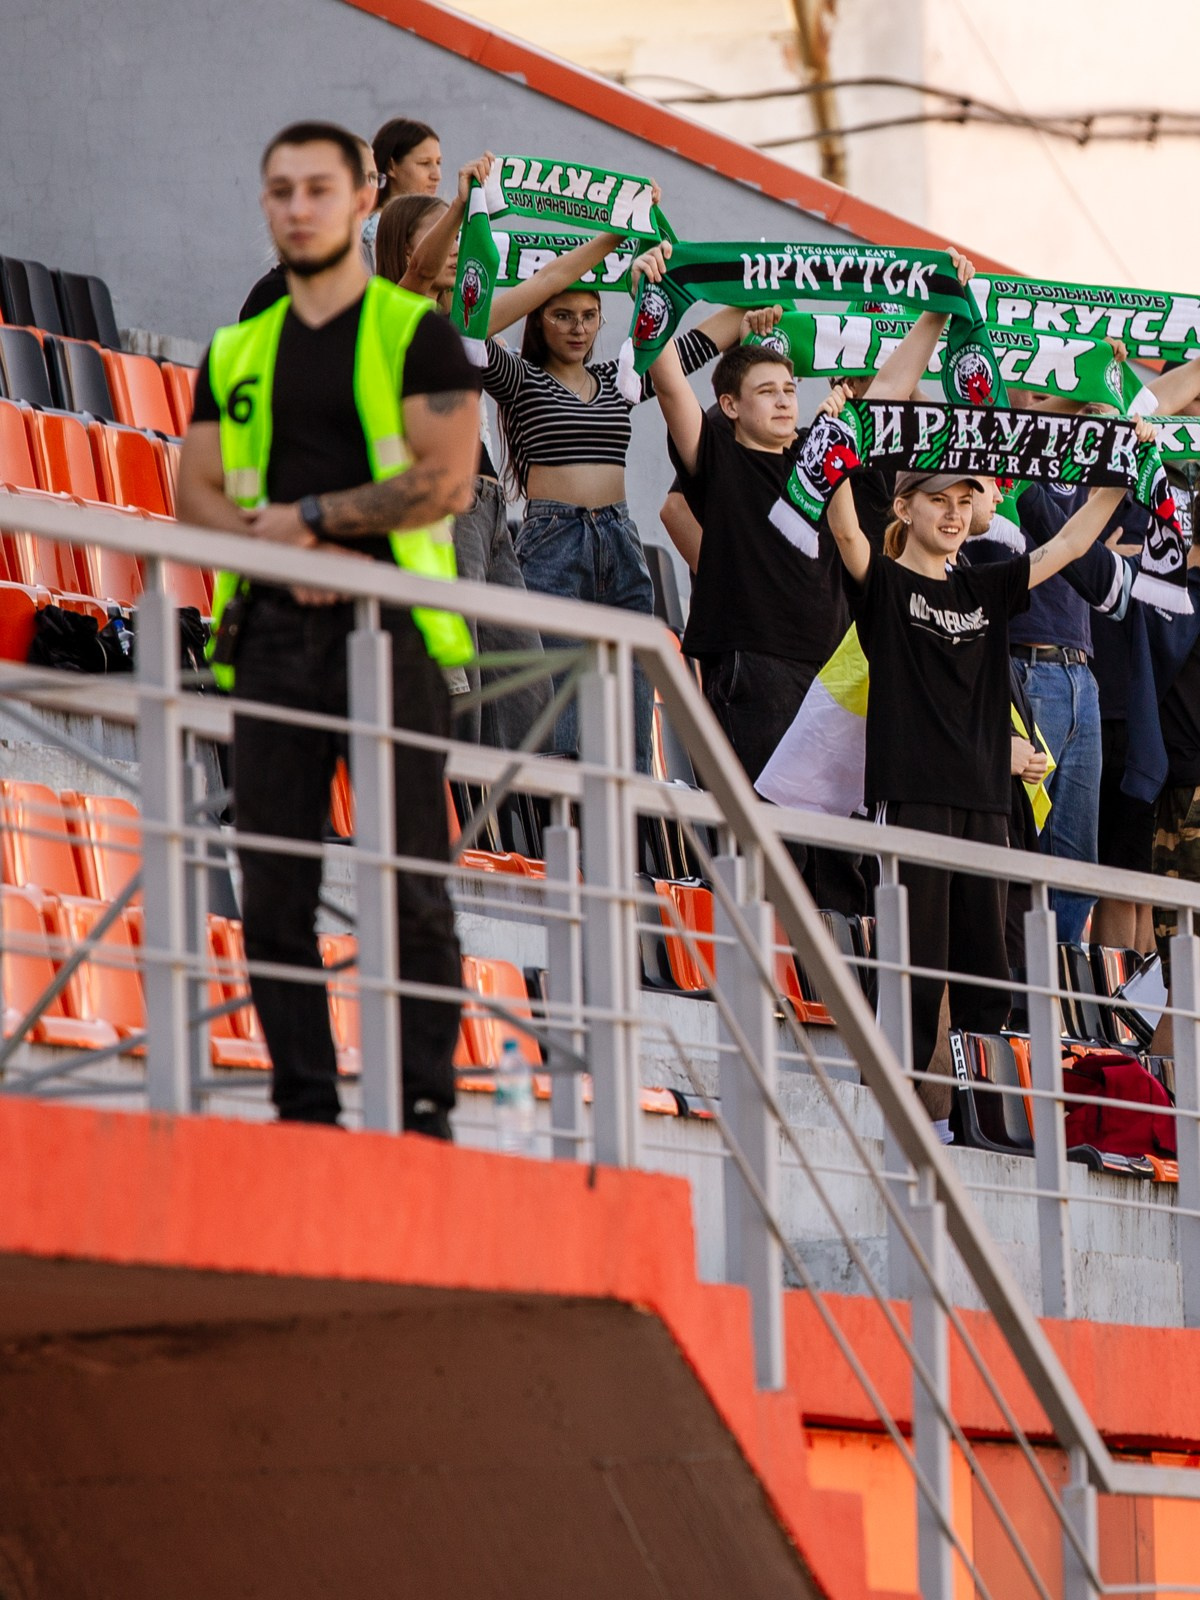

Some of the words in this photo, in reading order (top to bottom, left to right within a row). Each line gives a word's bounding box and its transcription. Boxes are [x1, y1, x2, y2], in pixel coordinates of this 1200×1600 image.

[534, 193, 609, 223] ФУТБОЛЬНЫЙ
[784, 244, 859, 257] ФУТБОЛЬНЫЙ
[865, 249, 897, 259] КЛУБ
[740, 253, 938, 300] ИРКУТСК
[994, 280, 1117, 304] ФУТБОЛЬНЫЙ
[1118, 292, 1168, 309] КЛУБ
[989, 330, 1034, 347] КЛУБ
[227, 374, 261, 424] 6
[869, 404, 1139, 481] ИРКУТСК
[947, 450, 1061, 479] ULTRAS
